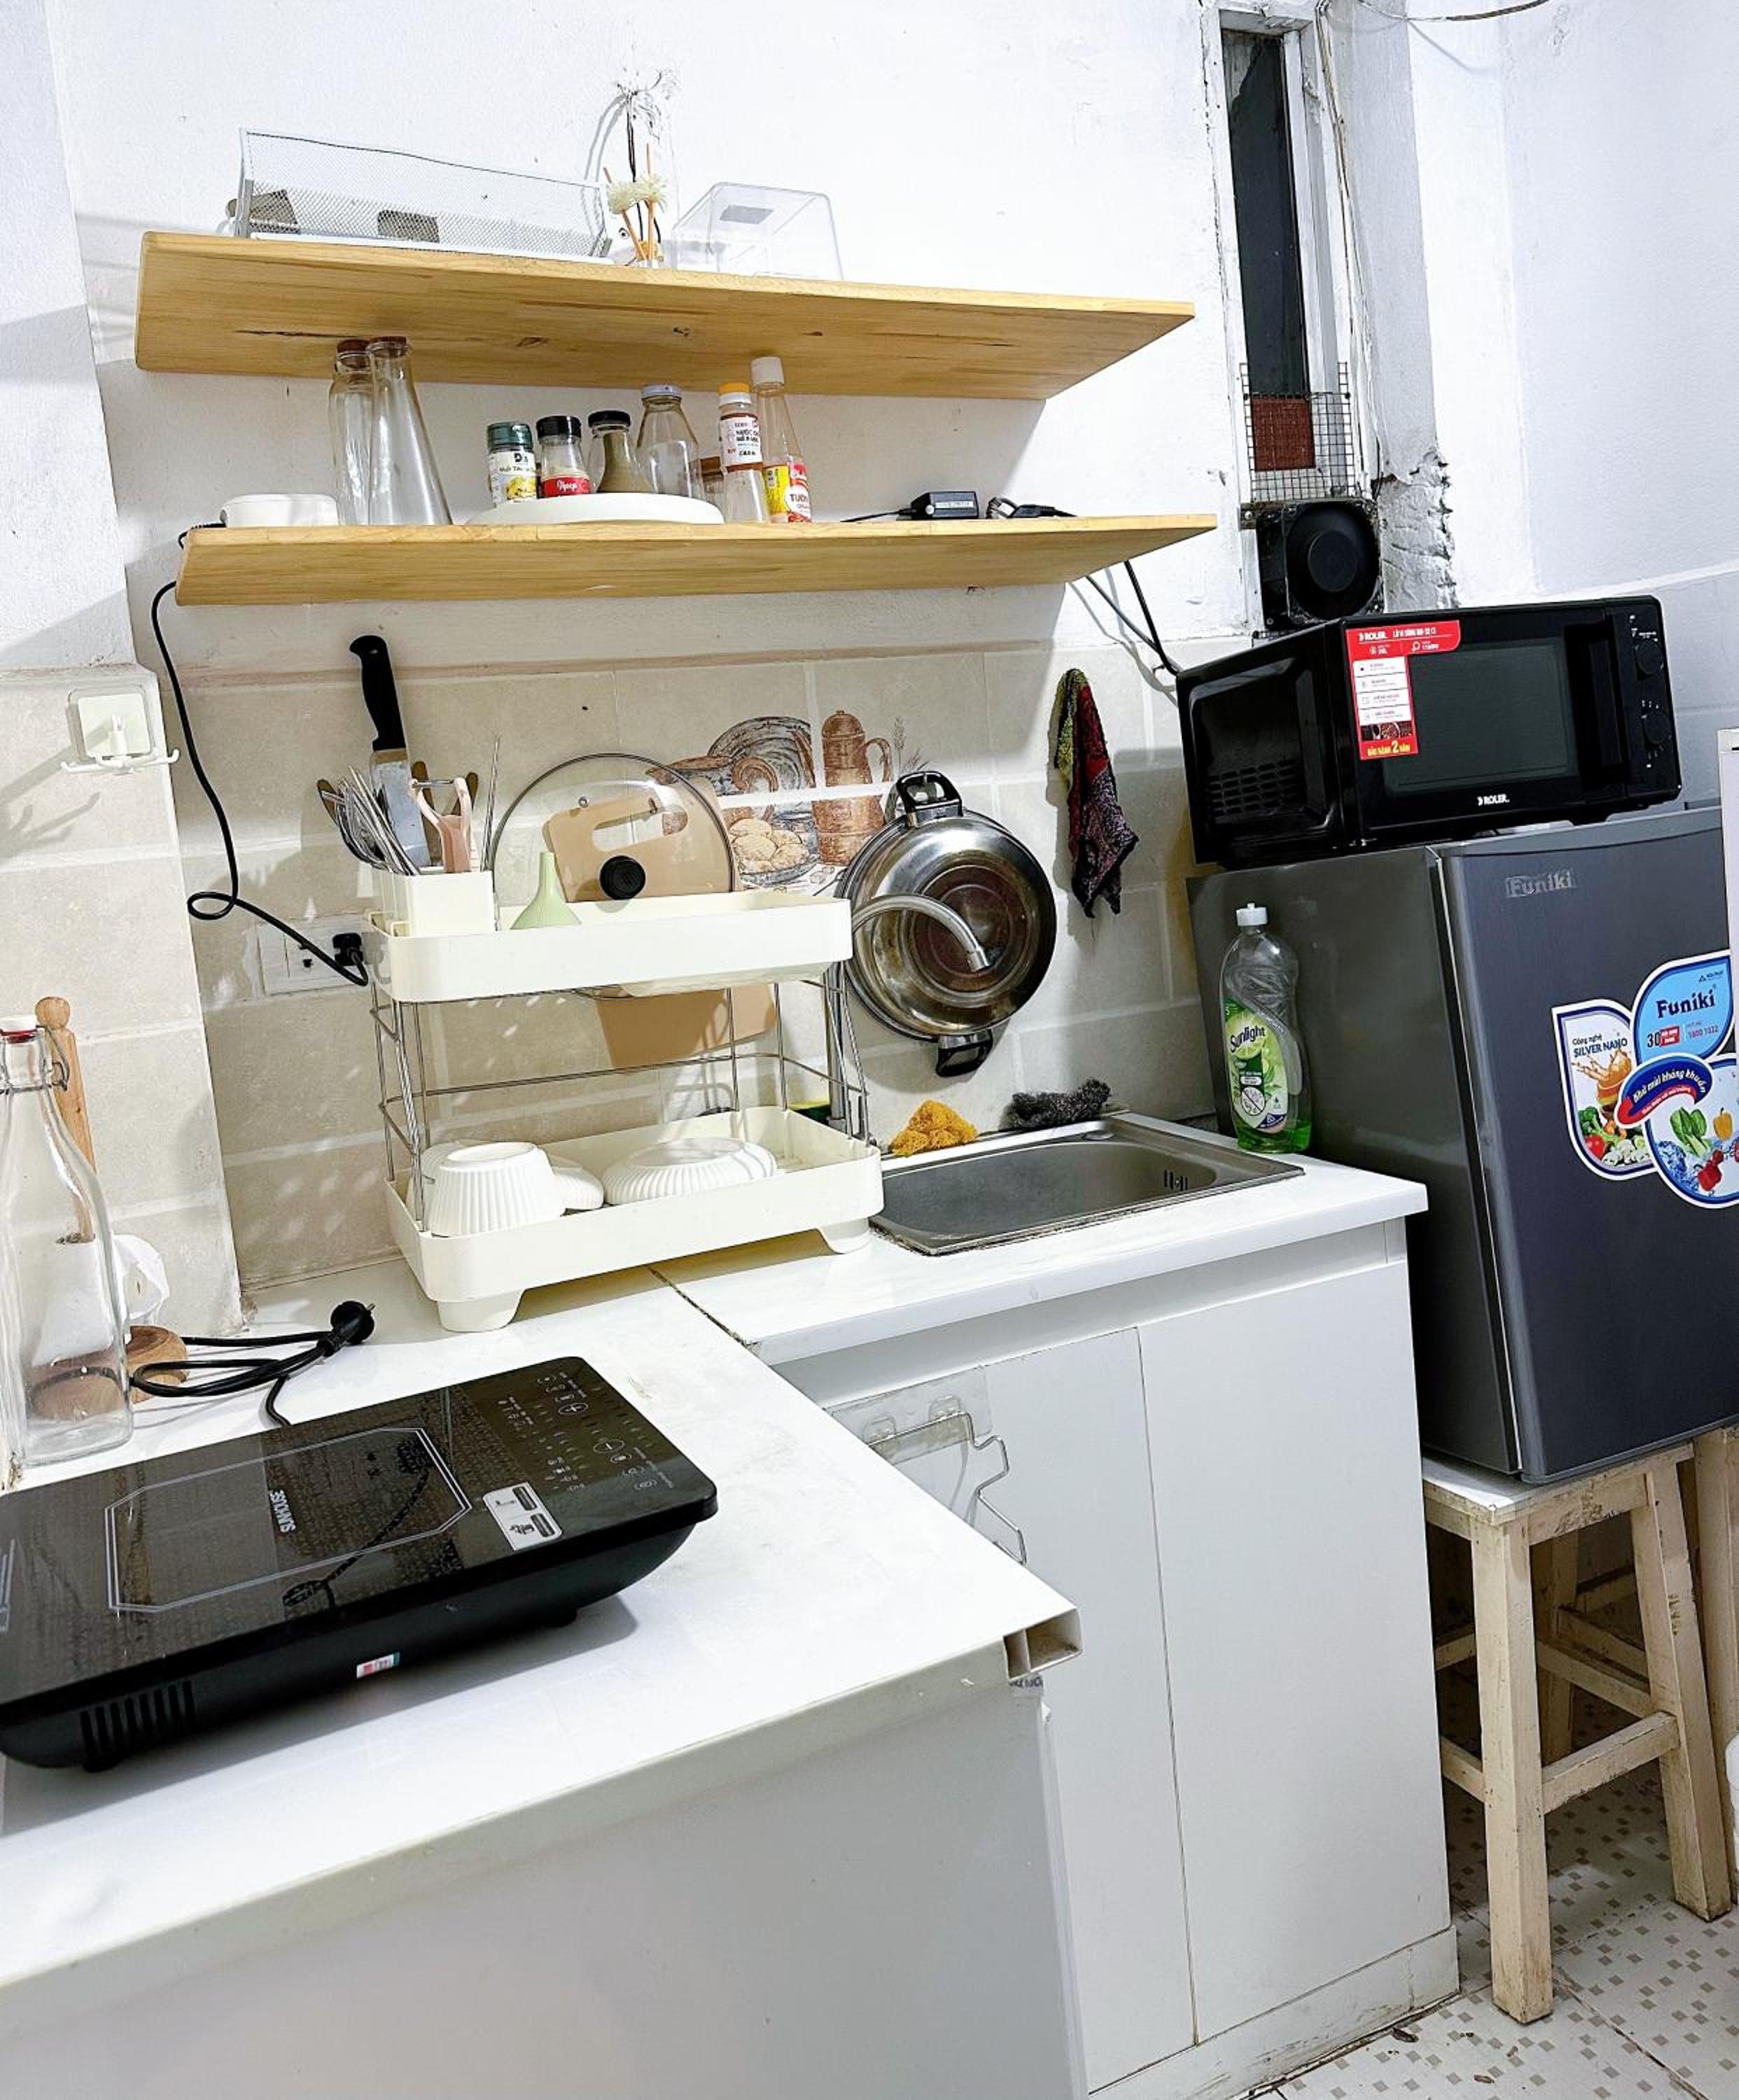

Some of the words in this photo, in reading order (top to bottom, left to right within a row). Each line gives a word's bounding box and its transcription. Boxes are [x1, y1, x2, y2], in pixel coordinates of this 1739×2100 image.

[1391, 739, 1399, 753] 2
[1656, 989, 1715, 1018] Funiki
[1231, 1025, 1266, 1053] Sunlight
[1573, 1043, 1602, 1058] SILVER
[1602, 1037, 1628, 1051] NANO
